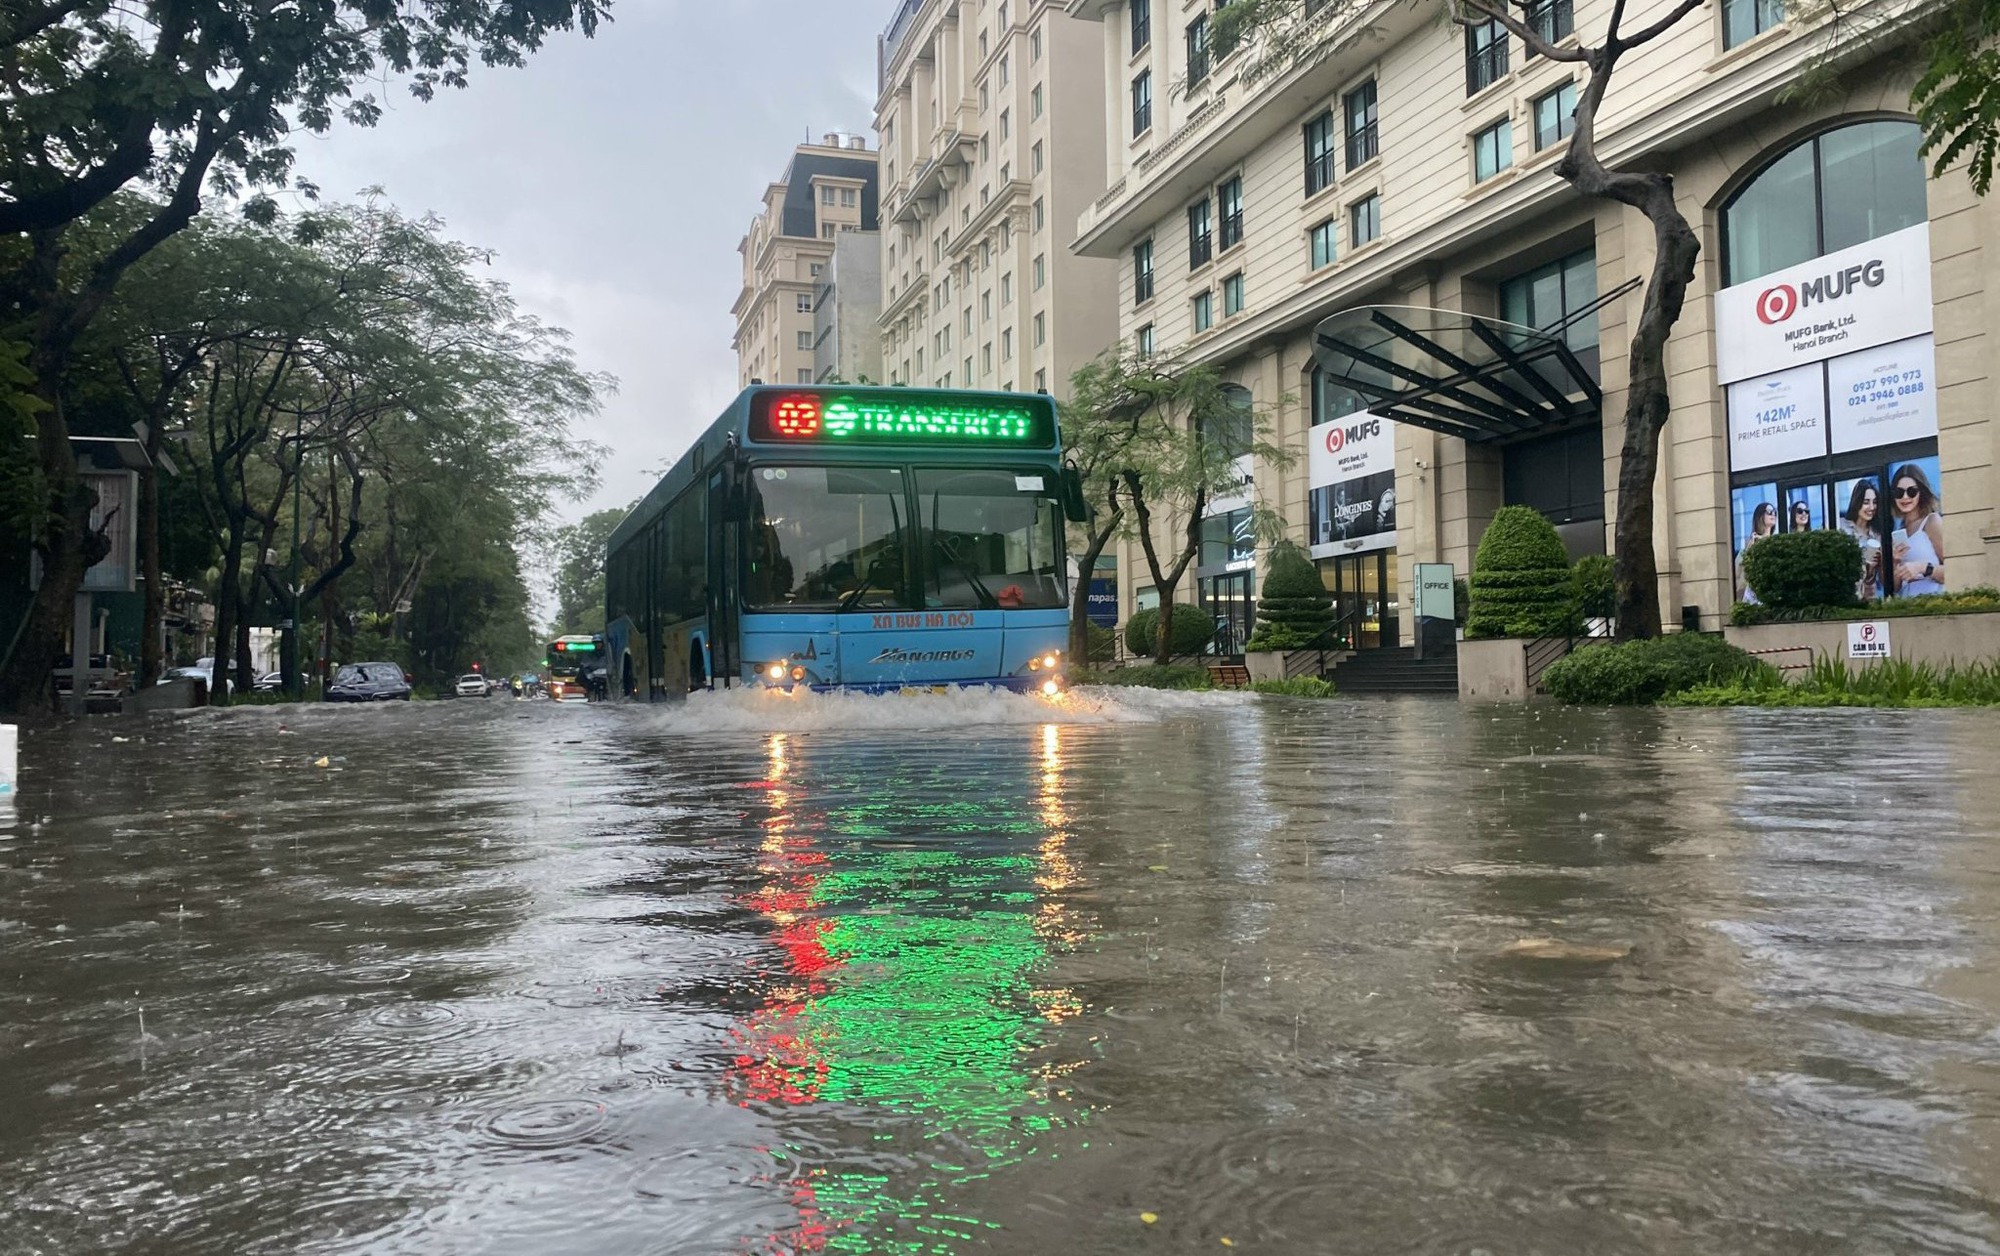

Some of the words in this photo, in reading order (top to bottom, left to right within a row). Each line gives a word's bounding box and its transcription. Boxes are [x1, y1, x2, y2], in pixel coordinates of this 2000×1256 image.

[1801, 260, 1885, 308] MUFG
[1784, 327, 1812, 342] MUFG
[1813, 320, 1838, 334] Bank,
[1838, 313, 1857, 327] Ltd.
[1793, 337, 1817, 352] Hanoi
[1818, 329, 1849, 346] Branch
[1853, 379, 1877, 393] 0937
[1880, 374, 1899, 387] 990
[1902, 369, 1921, 382] 973
[1848, 394, 1866, 406] 024
[1869, 388, 1895, 402] 3946
[1897, 382, 1924, 396] 0888
[1345, 419, 1380, 445] MUFG
[1738, 429, 1761, 441] PRIME
[1762, 424, 1788, 437] RETAIL
[1790, 418, 1817, 431] SPACE
[1334, 500, 1373, 518] LONGINES
[1424, 582, 1450, 590] OFFICE
[1088, 594, 1115, 604] napas
[895, 614, 921, 628] BUS
